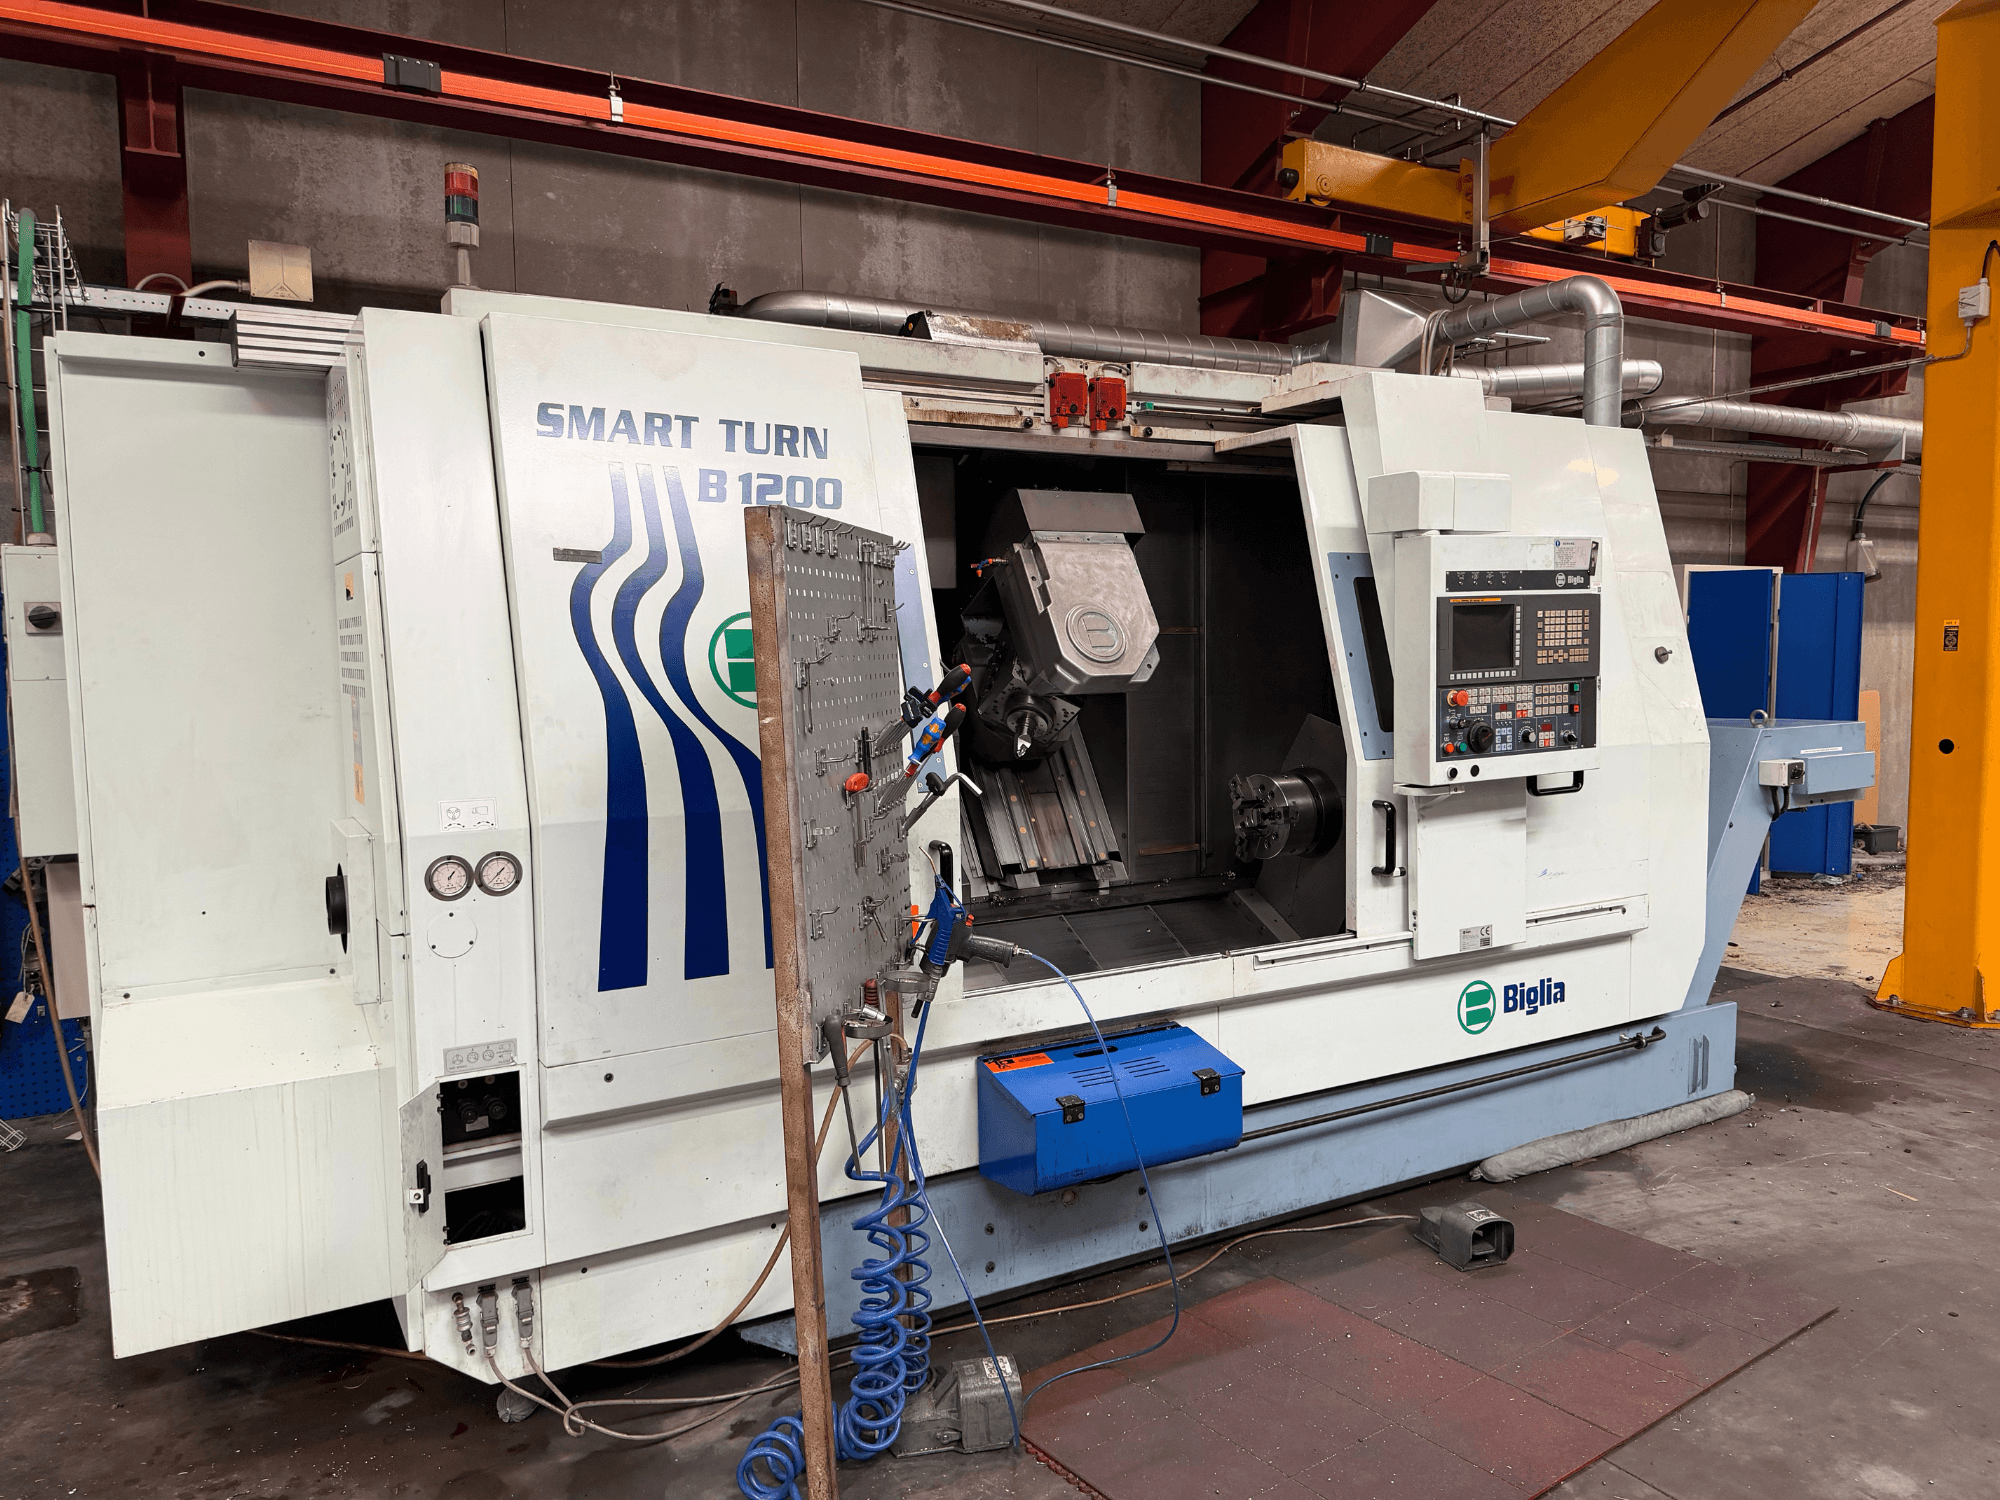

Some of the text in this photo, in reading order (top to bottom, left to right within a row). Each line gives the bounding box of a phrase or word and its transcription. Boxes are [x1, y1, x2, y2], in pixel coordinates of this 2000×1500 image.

[536, 402, 829, 459] SMART TURN
[697, 467, 843, 509] B 1200
[1567, 575, 1584, 585] Biglia
[1503, 977, 1565, 1016] Biglia
